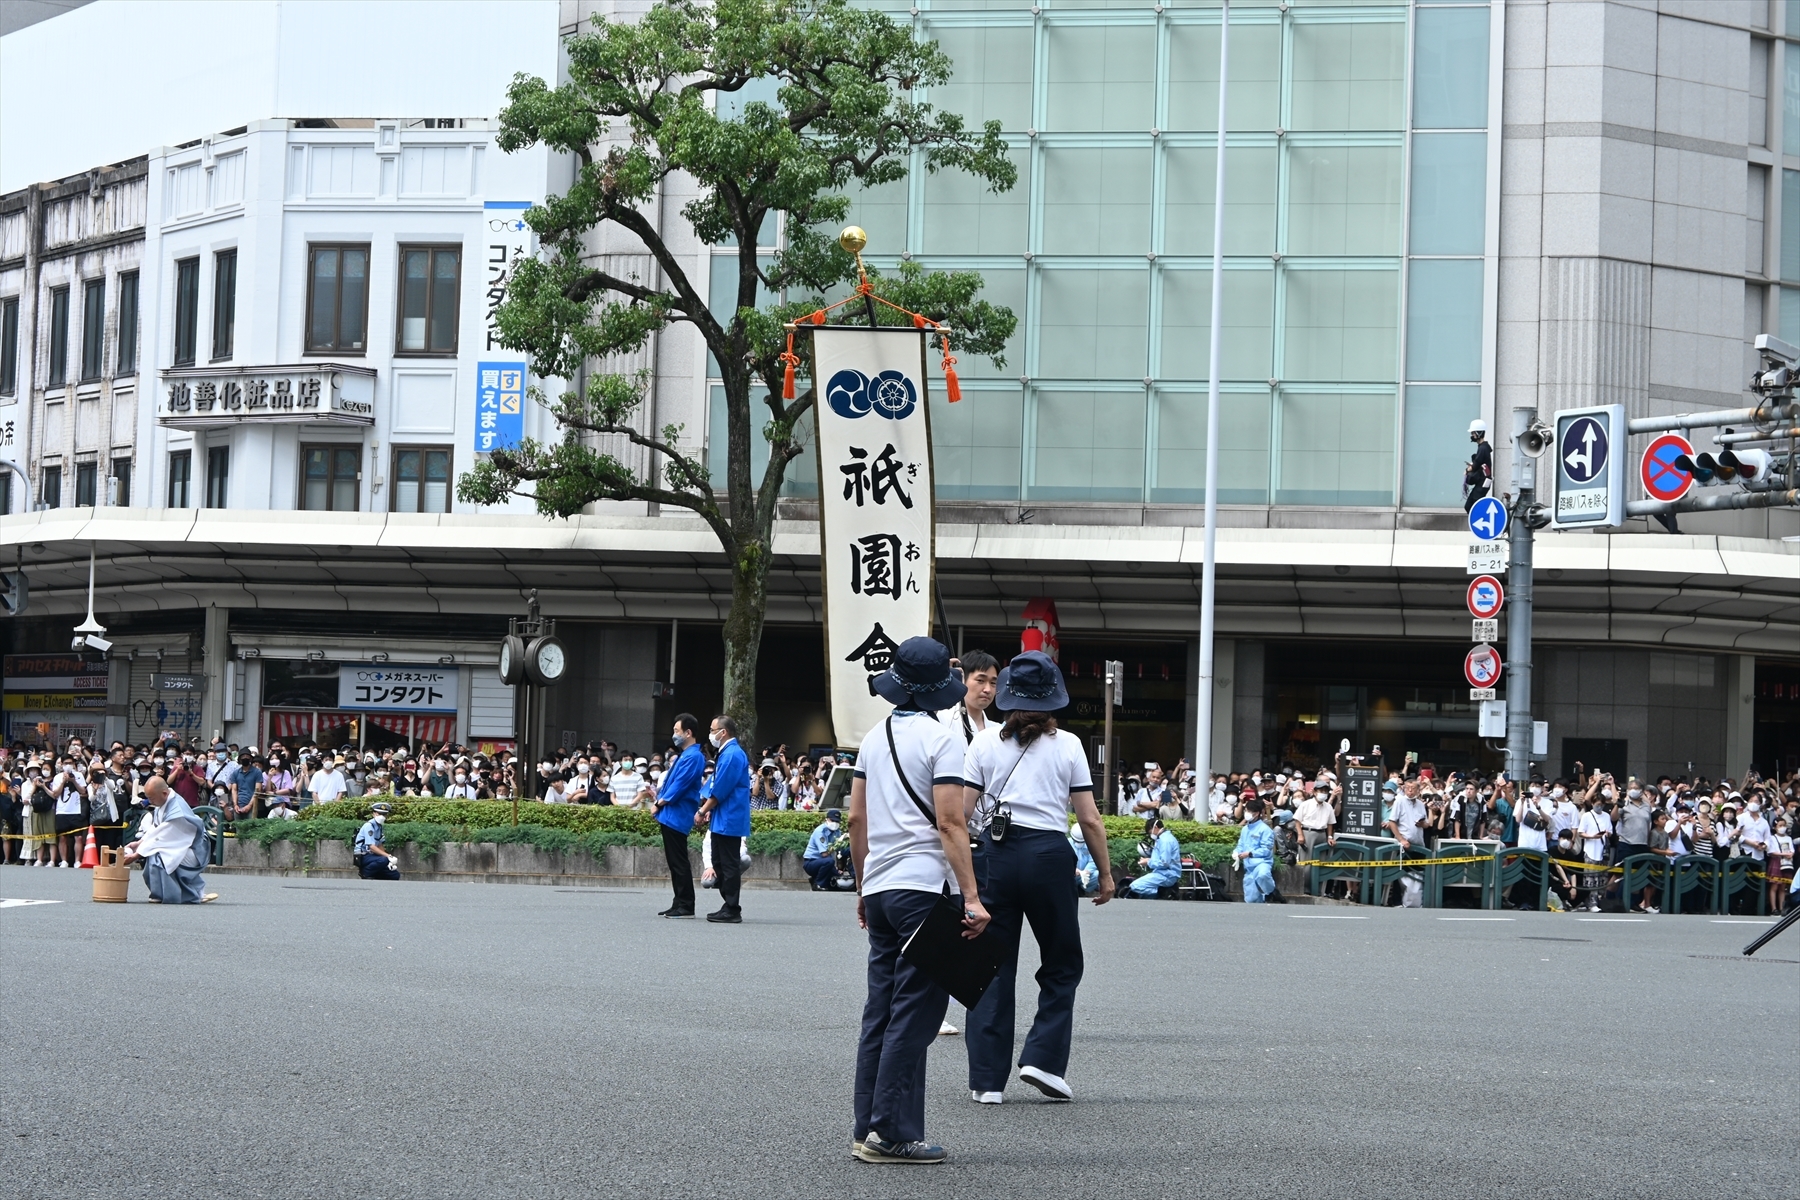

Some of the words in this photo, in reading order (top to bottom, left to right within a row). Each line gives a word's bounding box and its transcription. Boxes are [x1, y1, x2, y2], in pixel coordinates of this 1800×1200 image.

[167, 377, 321, 412] 池善化粧品店
[502, 372, 519, 412] すぐ
[480, 370, 500, 449] 買えます
[1559, 494, 1608, 510] 路線バスを除く
[73, 677, 91, 687] ACCESS
[92, 677, 108, 687] TICKET
[164, 681, 193, 689] コンタクト
[384, 672, 444, 682] メガネスーパー
[24, 695, 42, 708] Money
[44, 695, 72, 708] EXchange
[74, 698, 80, 707] No
[80, 697, 107, 707] Commission
[355, 685, 443, 704] コンタクト
[1091, 704, 1157, 717] Tashimaya
[895, 1142, 918, 1158] N
